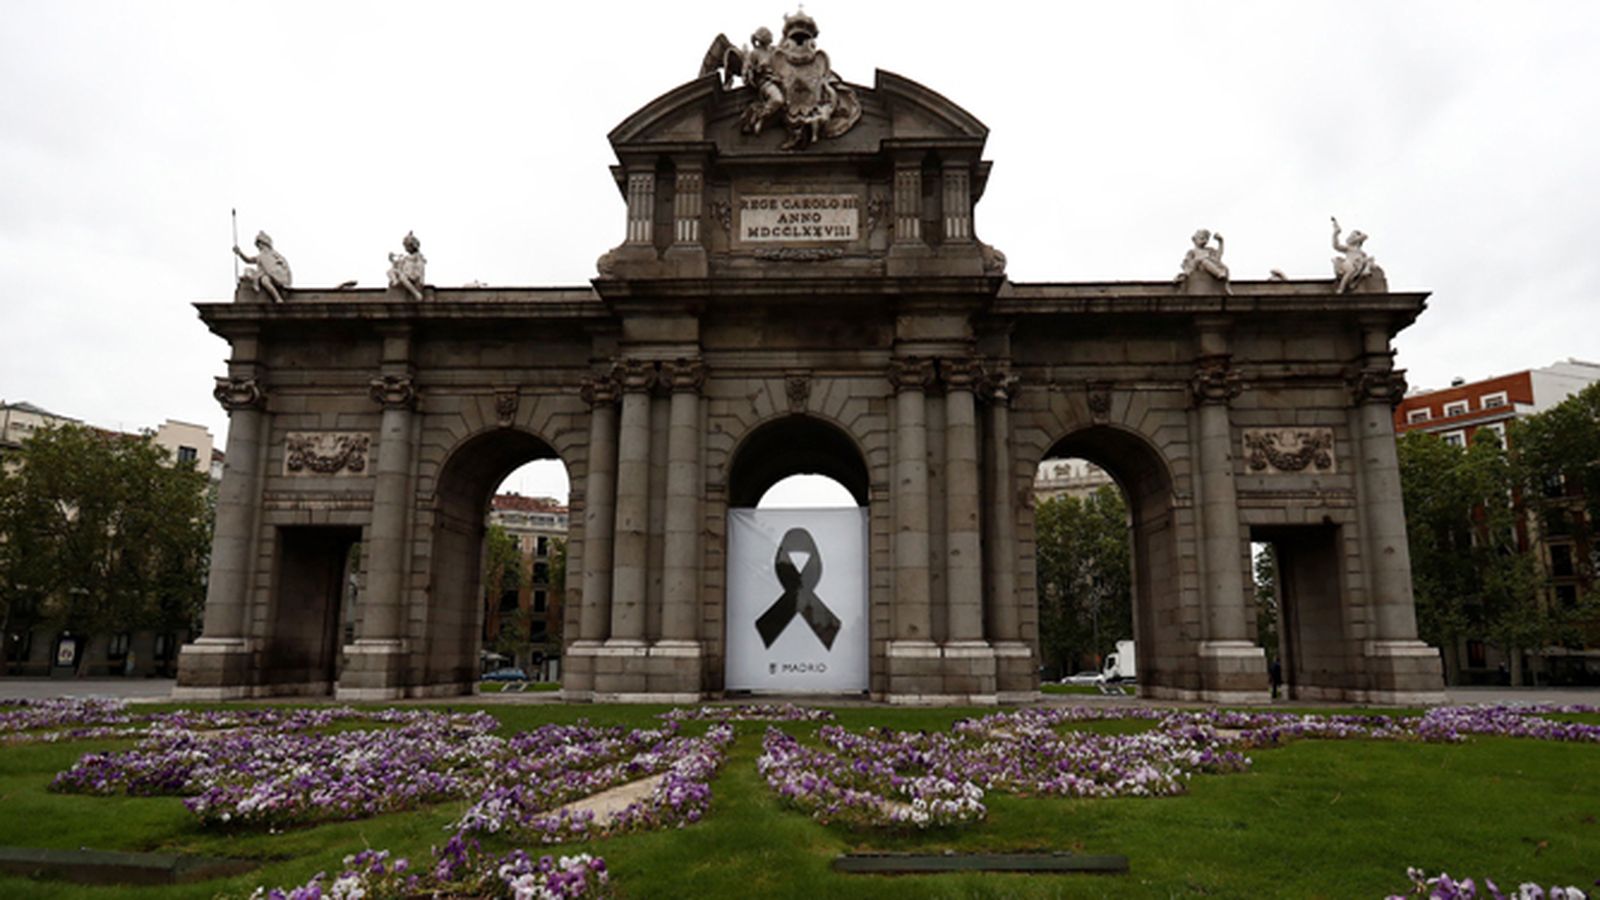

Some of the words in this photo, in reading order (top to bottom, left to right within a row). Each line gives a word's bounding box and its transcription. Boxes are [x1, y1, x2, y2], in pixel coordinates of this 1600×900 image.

[741, 199, 778, 210] REGE
[782, 199, 839, 210] CAROLO
[842, 199, 858, 209] III
[777, 212, 822, 224] ANNO
[748, 226, 851, 237] MDCCLXXVIII
[782, 663, 827, 673] MADRID
